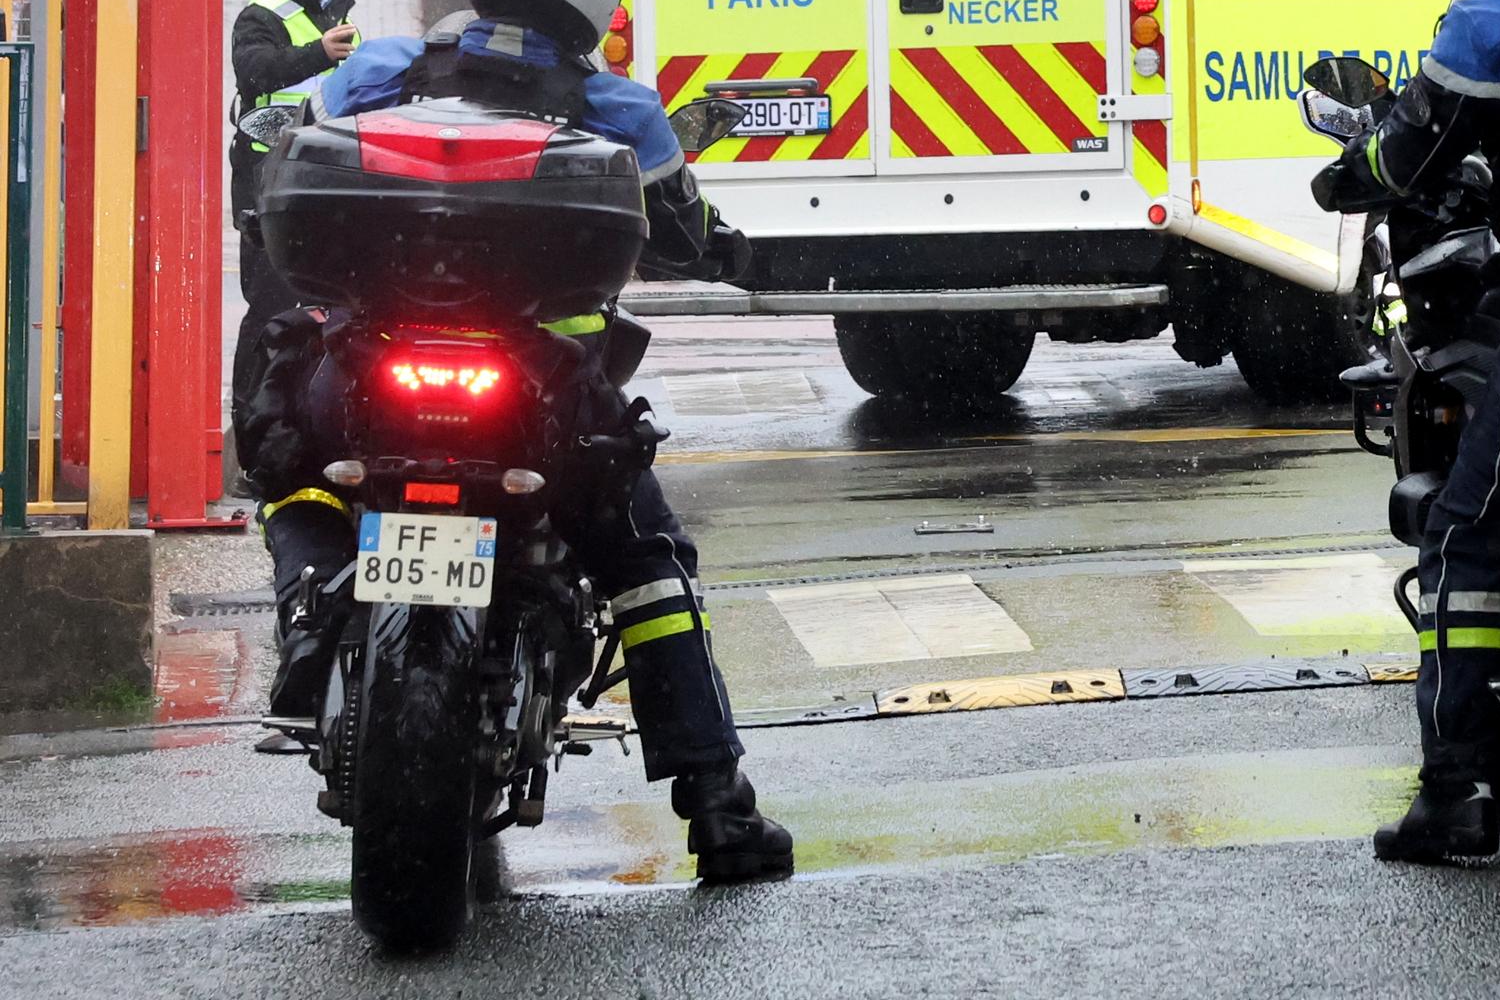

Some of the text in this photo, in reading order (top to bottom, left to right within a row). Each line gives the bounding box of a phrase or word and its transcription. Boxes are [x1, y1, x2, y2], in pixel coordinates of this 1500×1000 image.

[1204, 50, 1304, 102] SAMU
[741, 102, 815, 127] 390-QT
[1076, 139, 1103, 149] WAS
[478, 541, 493, 555] 75
